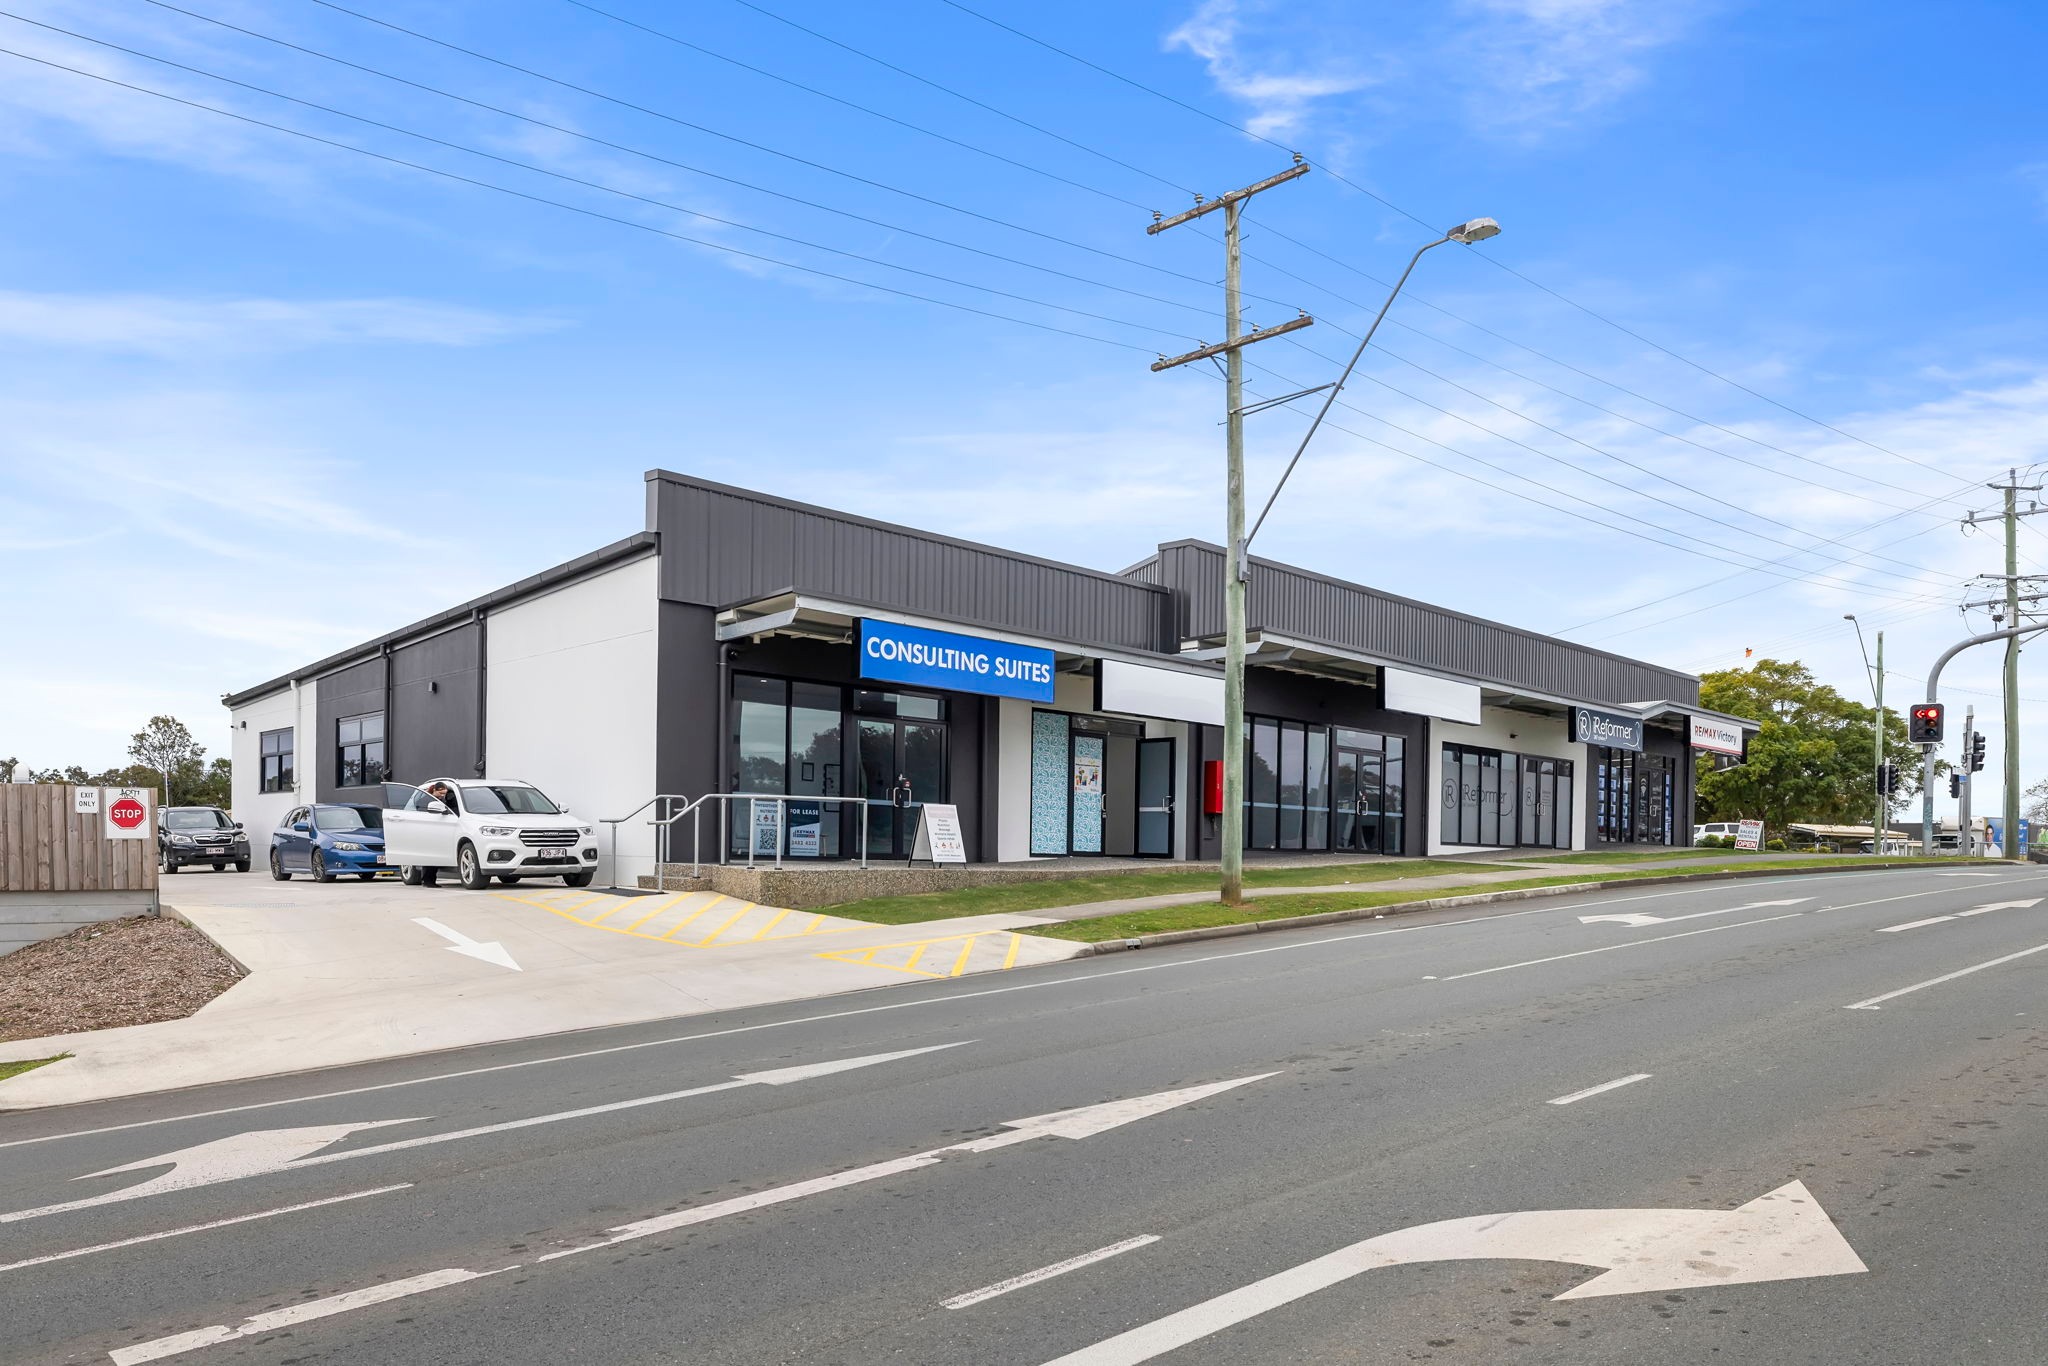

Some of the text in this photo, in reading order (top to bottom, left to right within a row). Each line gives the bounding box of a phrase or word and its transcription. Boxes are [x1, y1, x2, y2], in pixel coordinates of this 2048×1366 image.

[867, 636, 1051, 684] CONSULTING SUITES
[1593, 716, 1633, 740] Reformer
[1694, 725, 1738, 746] RE/MAX Victory
[114, 809, 142, 819] STOP
[1737, 840, 1757, 848] OPEN
